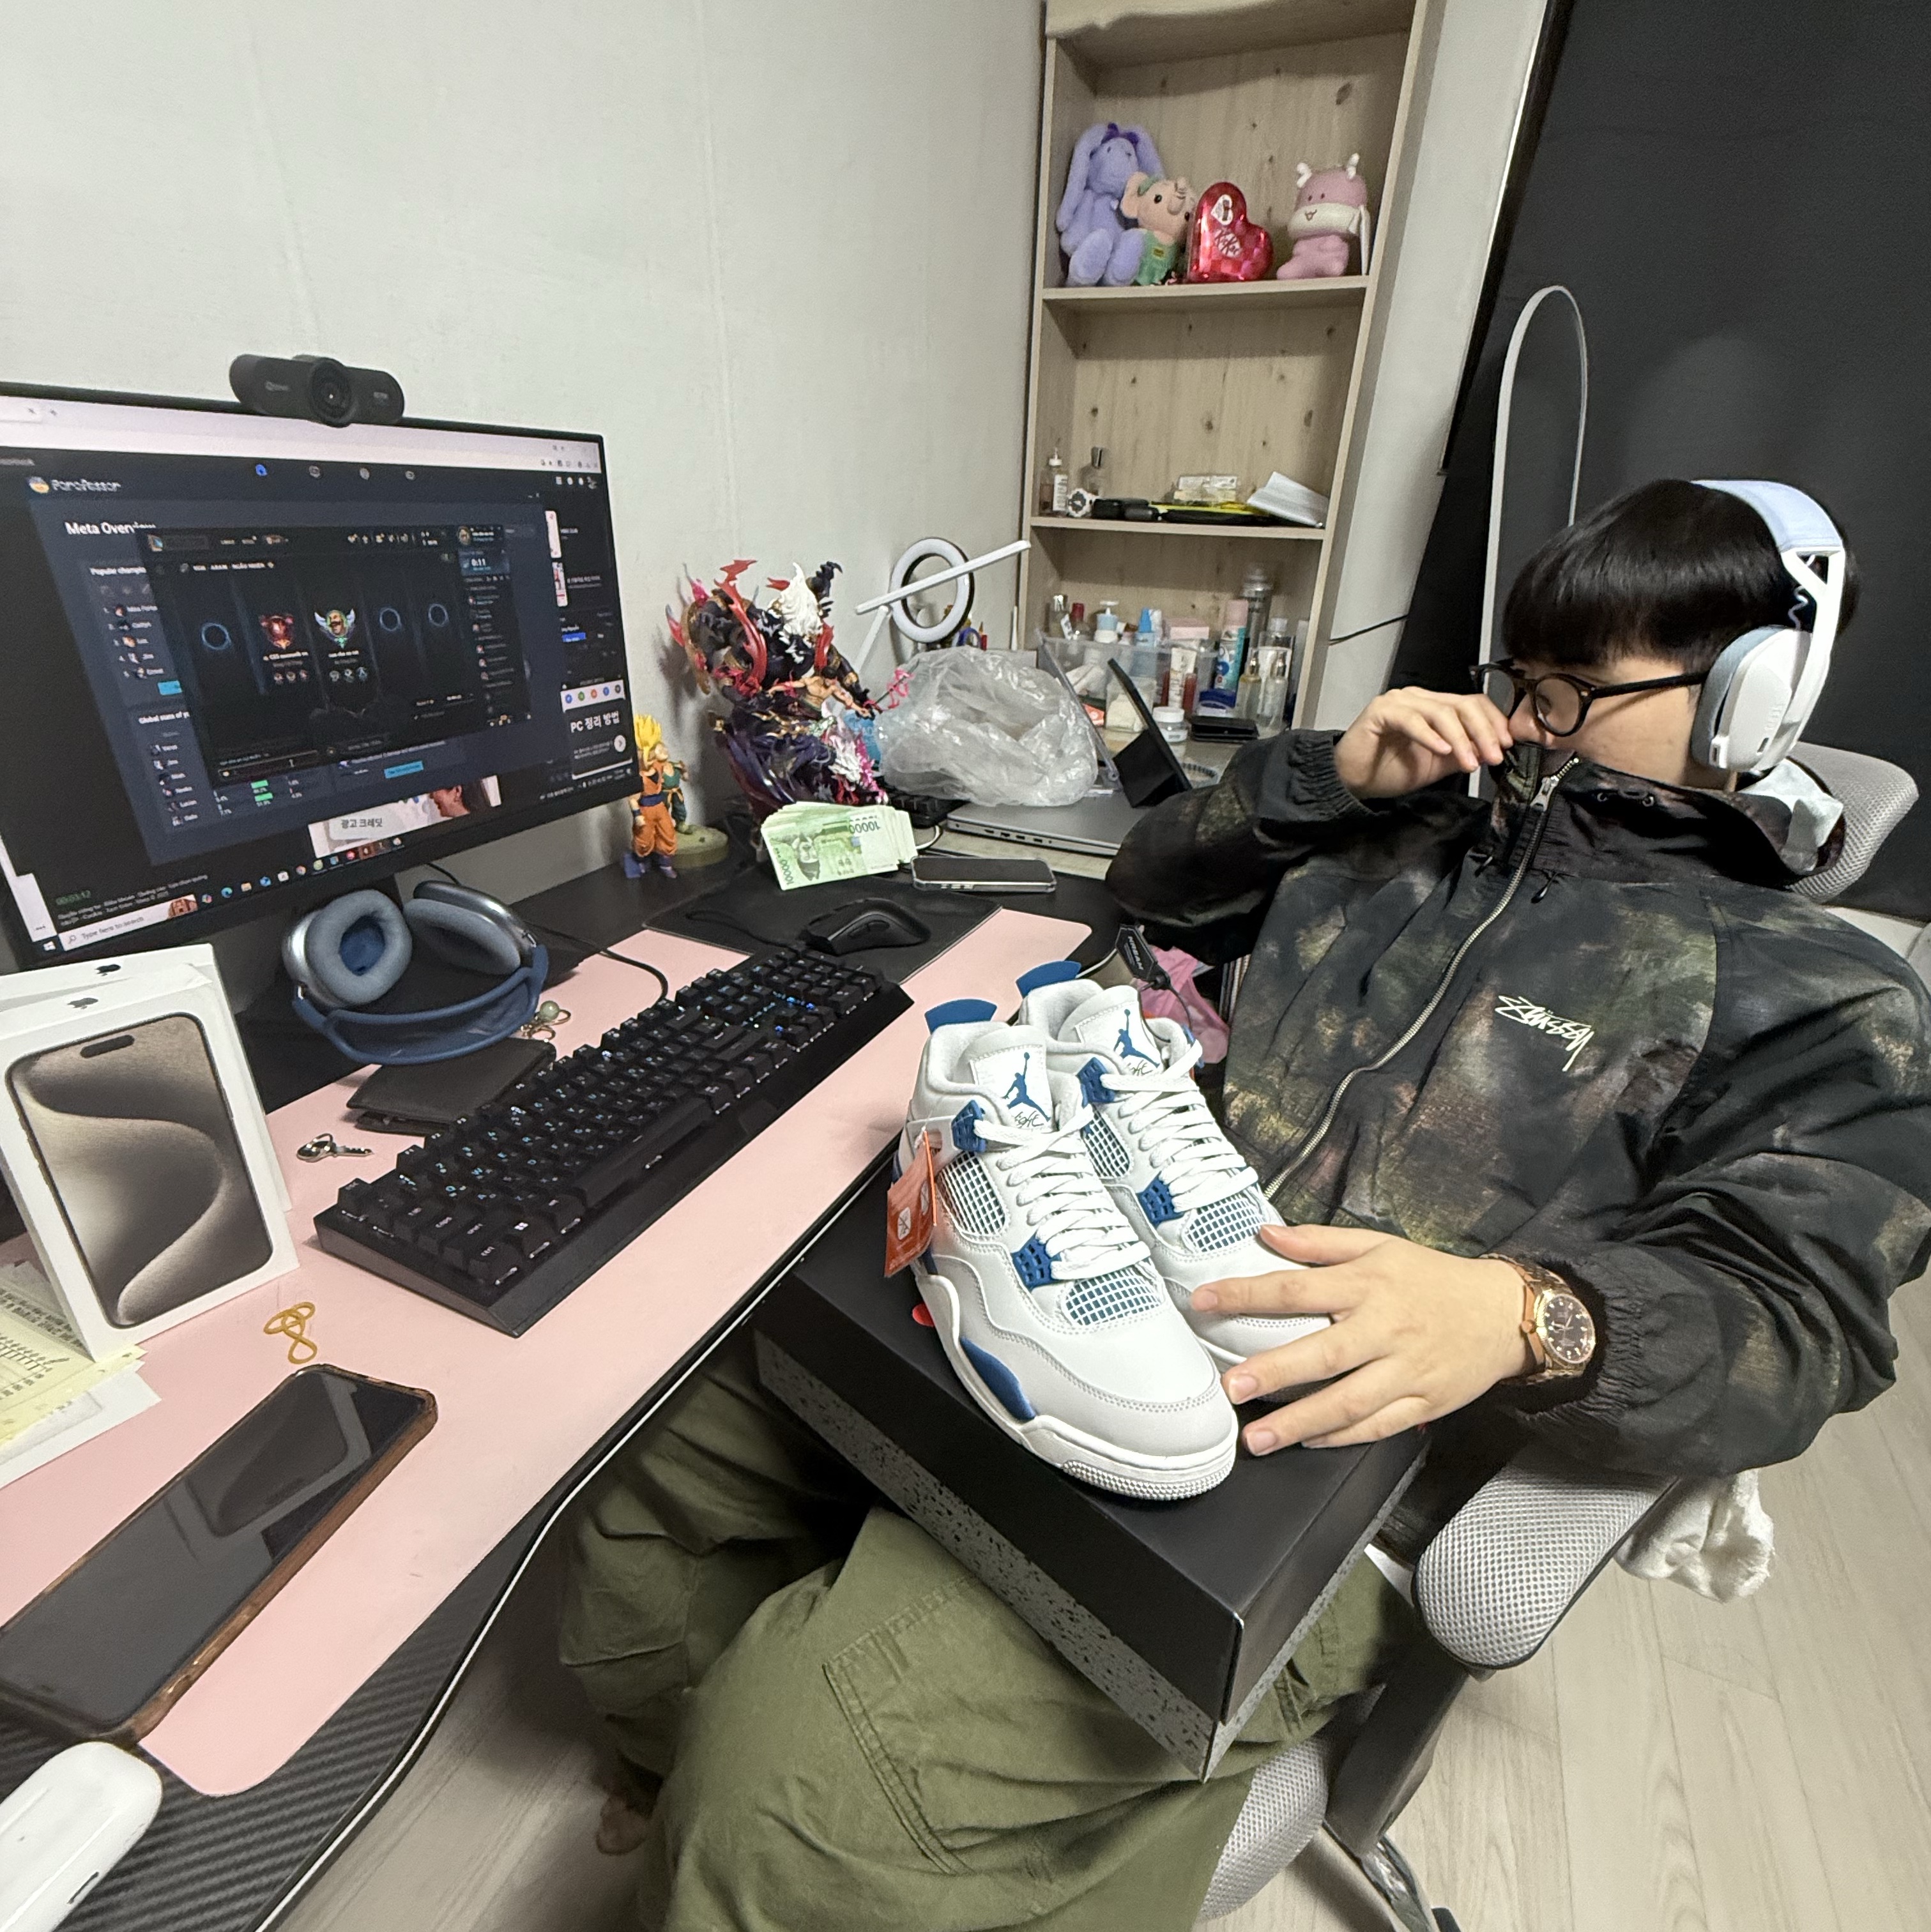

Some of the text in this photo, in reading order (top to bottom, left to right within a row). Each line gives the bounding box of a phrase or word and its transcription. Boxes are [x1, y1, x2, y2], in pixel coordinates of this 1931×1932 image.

[65, 522, 100, 535] Meta
[570, 711, 620, 733] PC 정리 방법
[341, 818, 383, 829] 광고 크레딧
[848, 821, 881, 835] 10000
